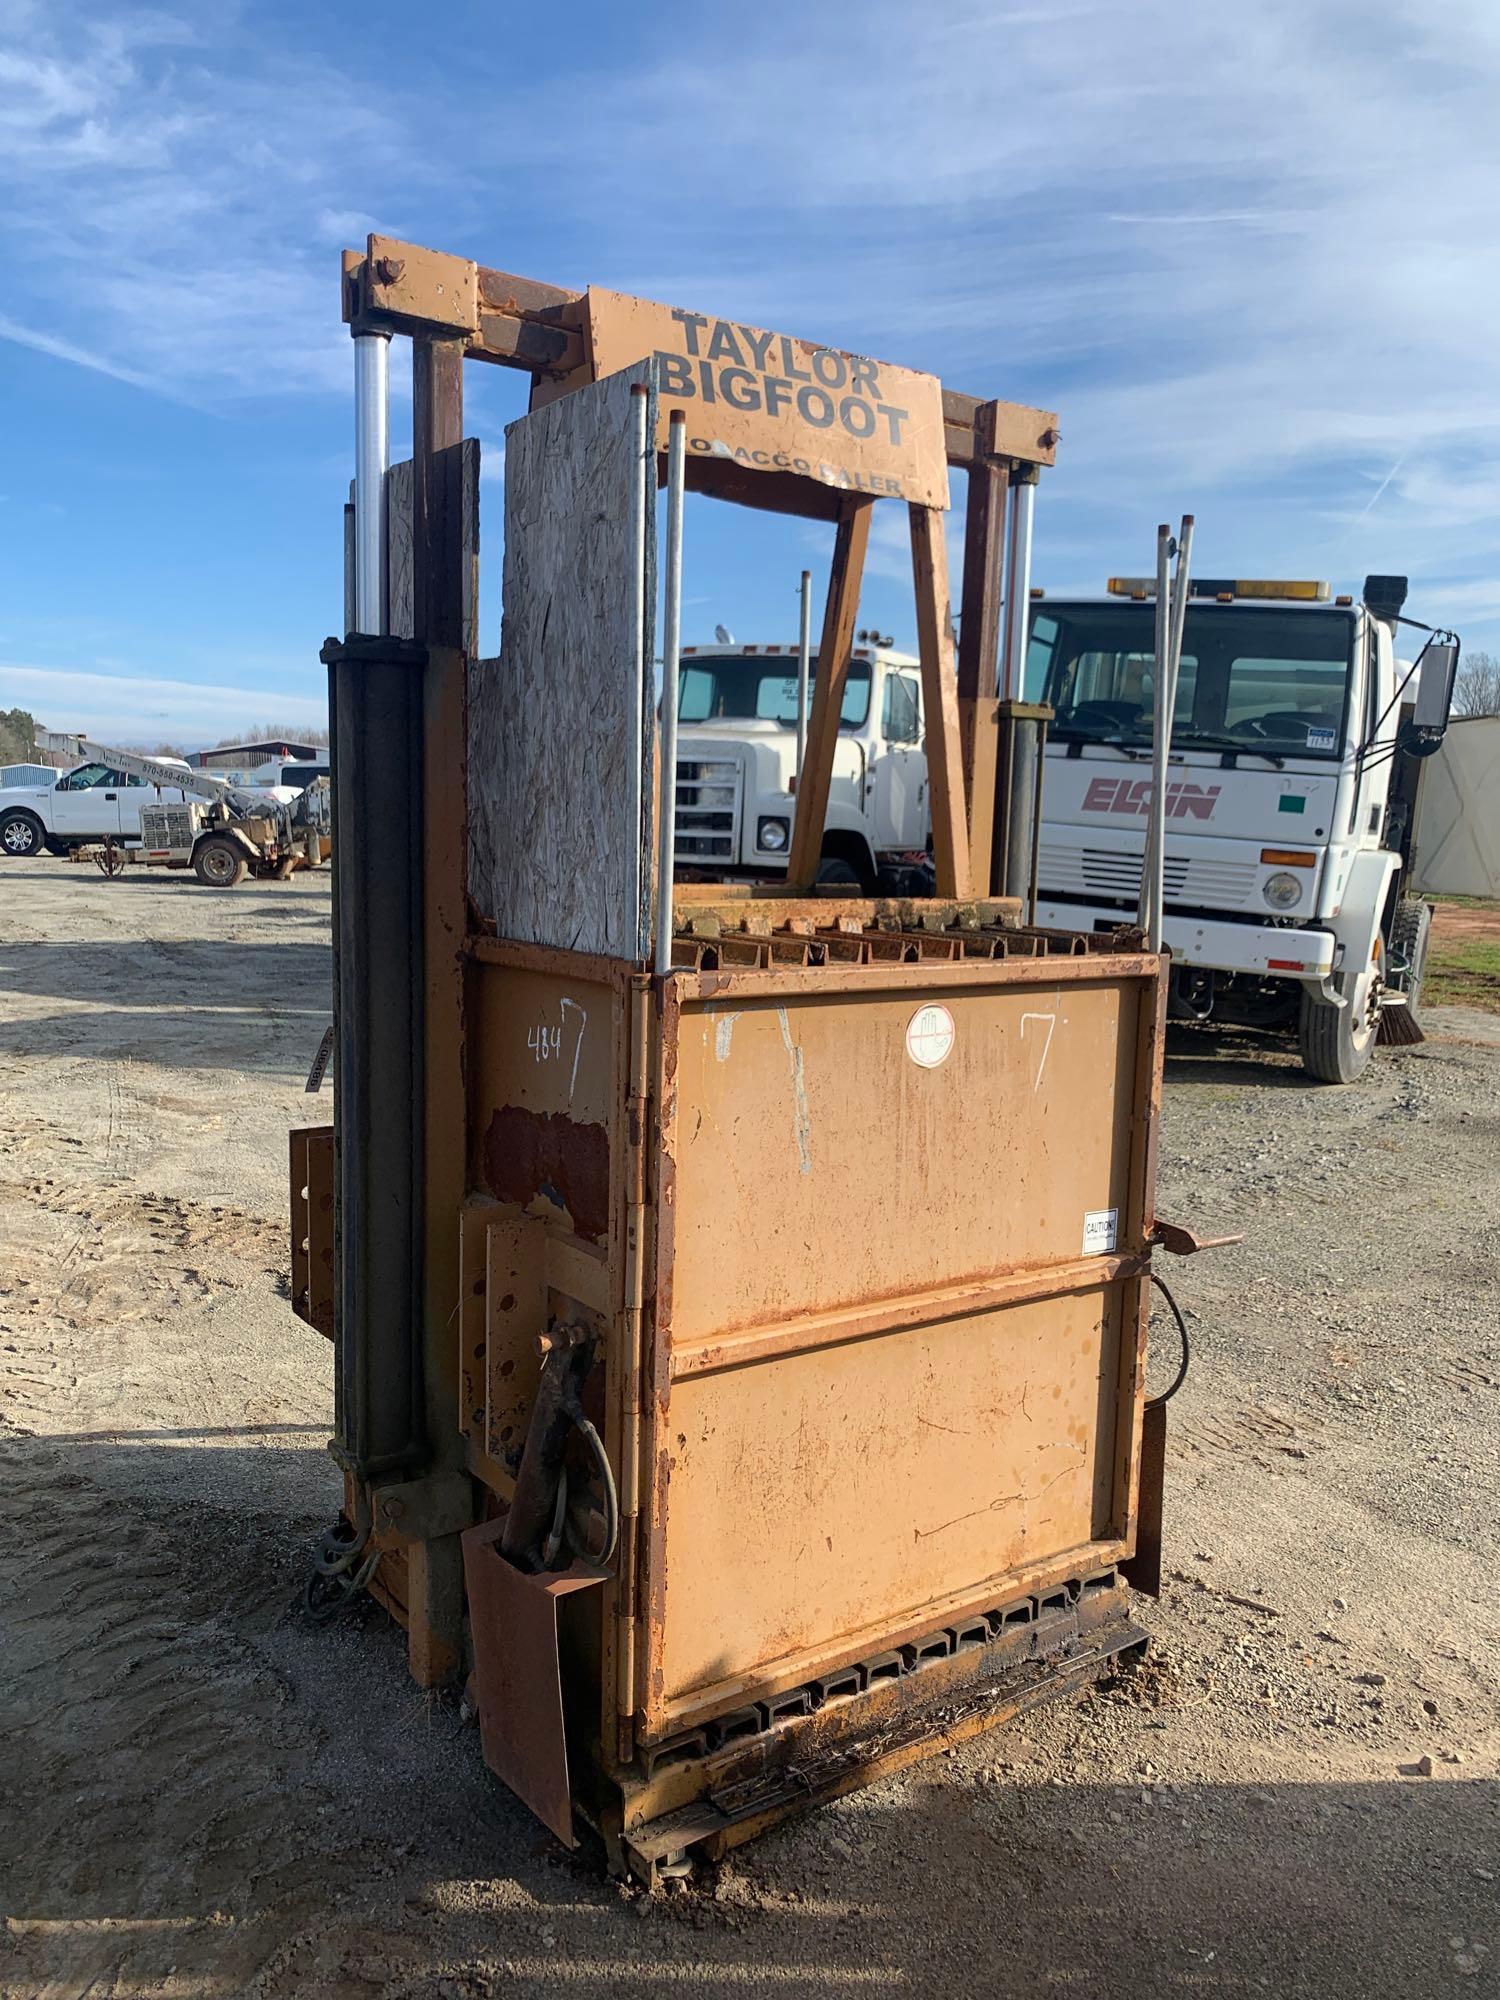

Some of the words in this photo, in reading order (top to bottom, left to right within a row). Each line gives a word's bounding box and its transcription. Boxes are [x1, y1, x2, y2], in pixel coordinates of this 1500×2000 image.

[653, 350, 909, 447] BIGFOOT
[671, 309, 883, 400] TAYLOR
[1020, 1013, 1055, 1093] 7
